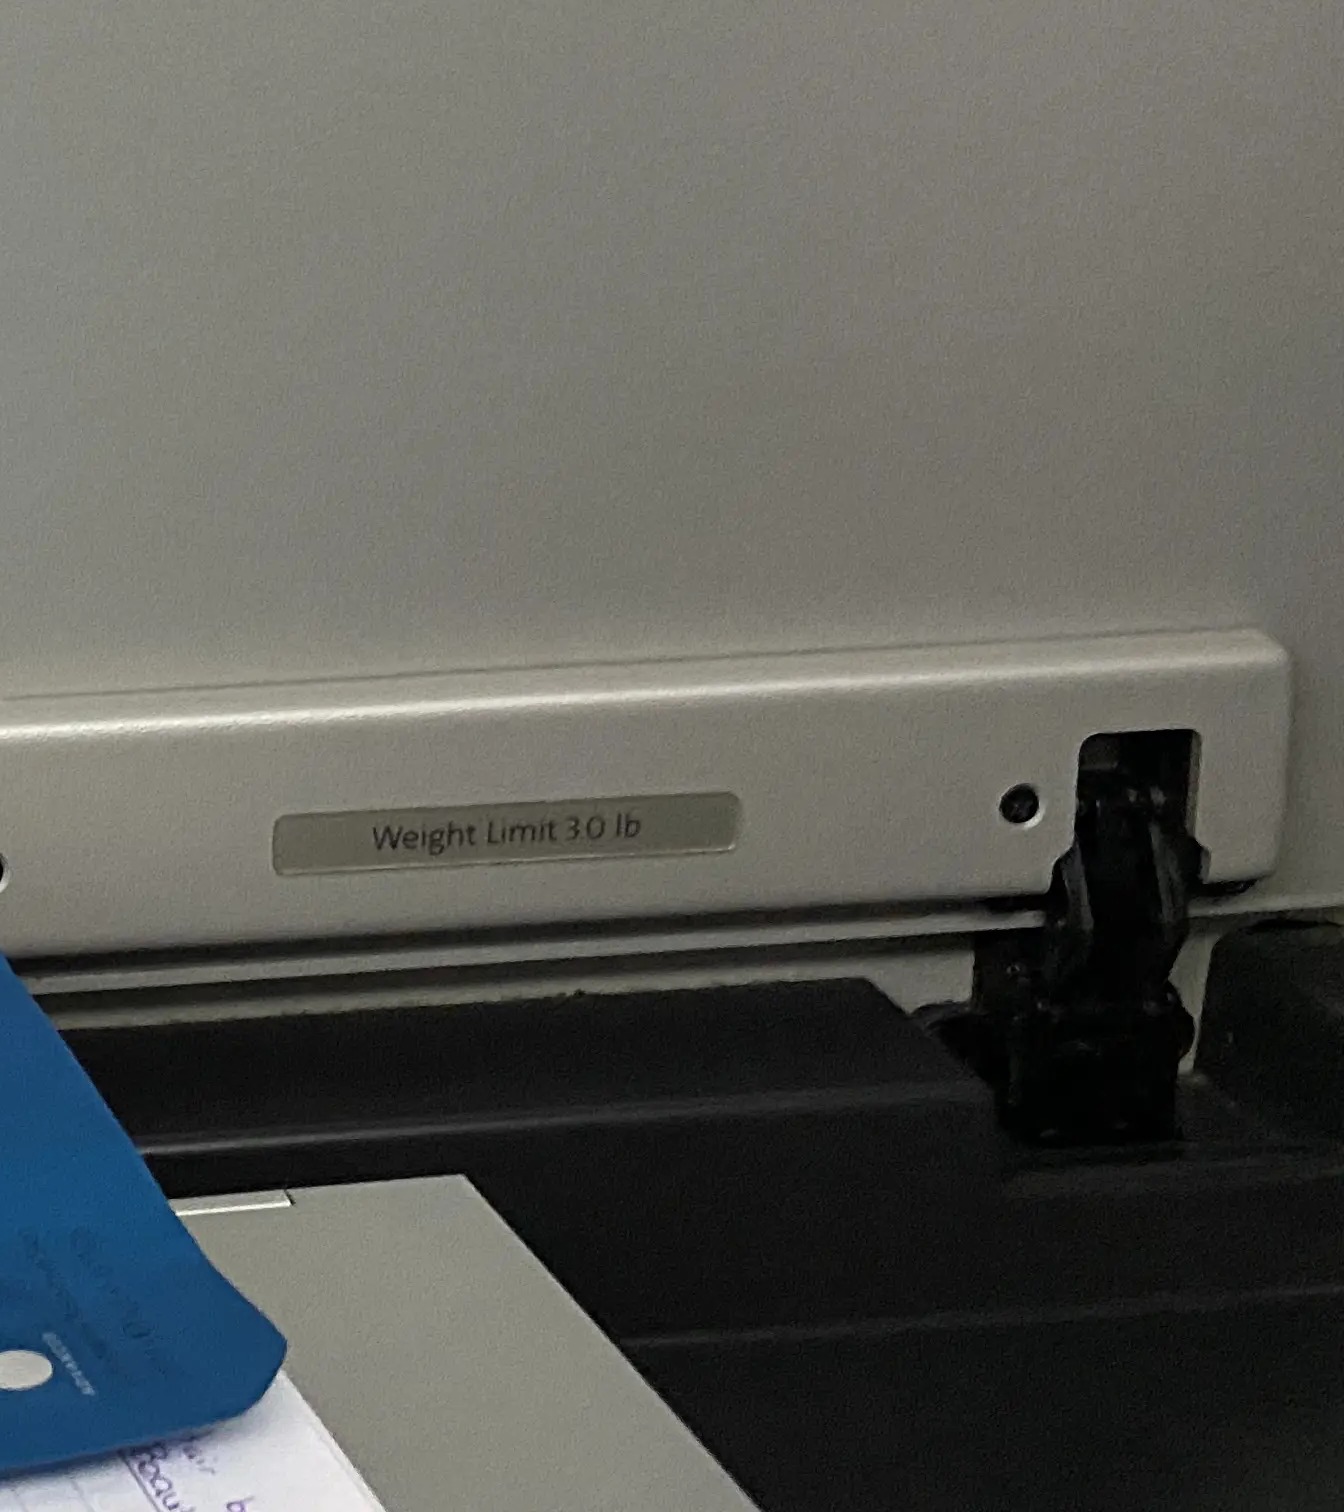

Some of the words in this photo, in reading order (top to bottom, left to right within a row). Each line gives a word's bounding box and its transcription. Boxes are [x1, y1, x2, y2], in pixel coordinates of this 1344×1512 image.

[372, 819, 477, 856] Weight
[486, 819, 558, 845] Limit
[614, 812, 642, 839] lb
